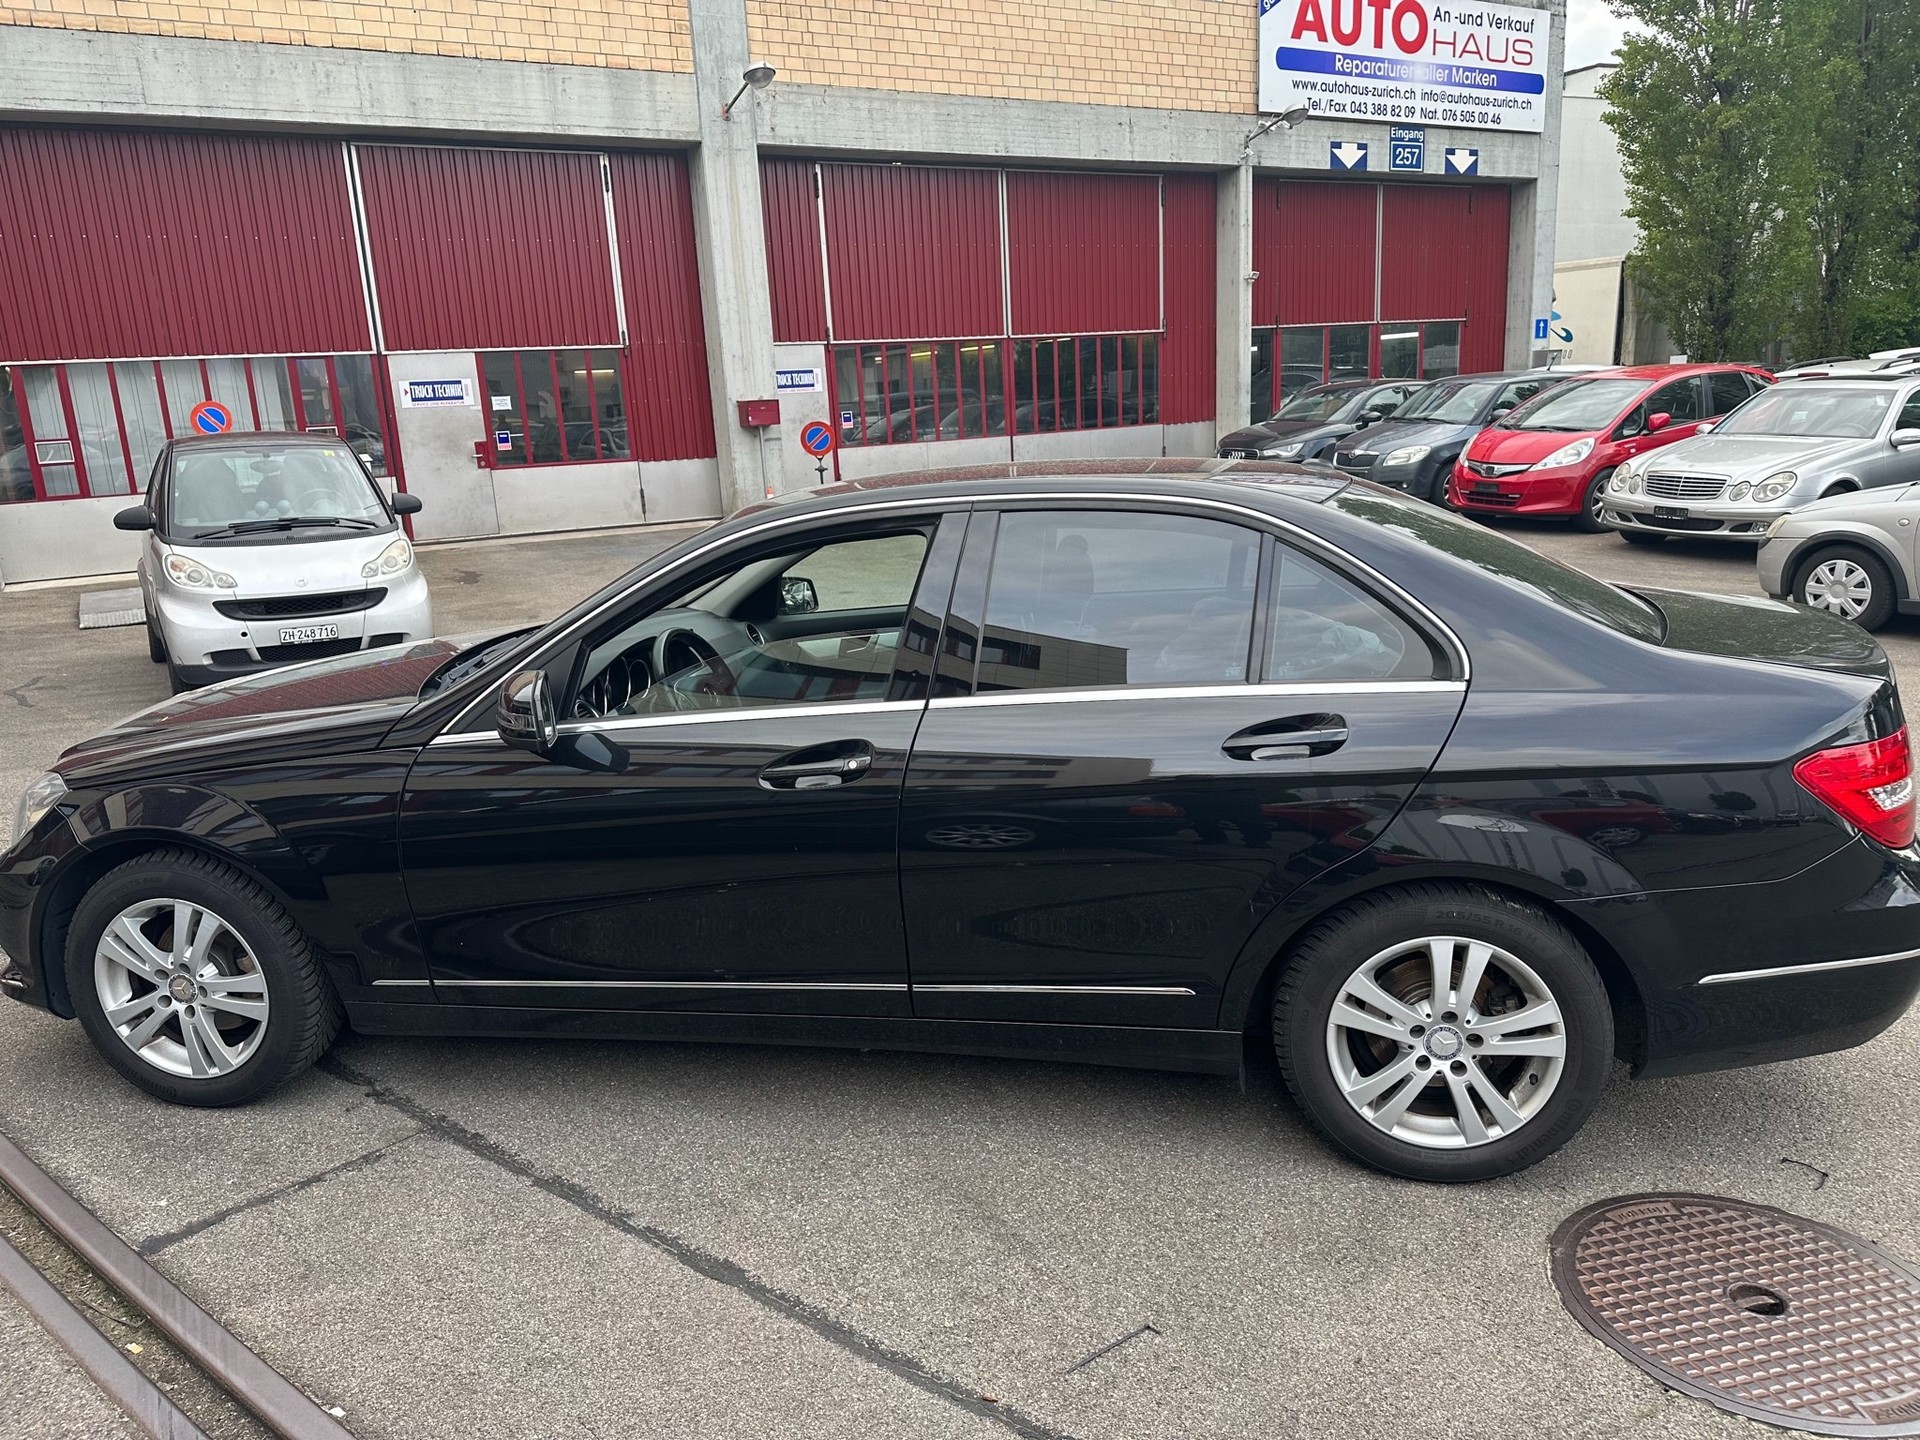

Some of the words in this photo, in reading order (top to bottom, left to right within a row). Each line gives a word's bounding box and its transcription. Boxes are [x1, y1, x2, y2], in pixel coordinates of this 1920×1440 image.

[1290, 0, 1428, 54] AUTO
[1433, 6, 1451, 23] An
[1487, 13, 1535, 33] Verkauf
[1432, 28, 1533, 66] HAUS
[1451, 67, 1497, 87] Marken
[1292, 79, 1416, 100] www.autohaus-zurich.ch
[1420, 88, 1532, 110] info@autohaus-zurich.ch
[1307, 97, 1347, 114] Tel./Fax
[1350, 101, 1368, 114] 043
[1371, 103, 1388, 117] 388
[1390, 105, 1403, 118] 82
[1404, 106, 1416, 119] 09
[1420, 107, 1439, 121] Nat.
[1442, 109, 1458, 122] 076
[1460, 110, 1476, 123] 505
[1478, 111, 1489, 124] 00
[1491, 113, 1502, 125] 46
[1391, 127, 1424, 142] Eingang
[1395, 147, 1420, 165] 257
[410, 384, 433, 399] TRUCK
[433, 383, 463, 398] TECHNIK
